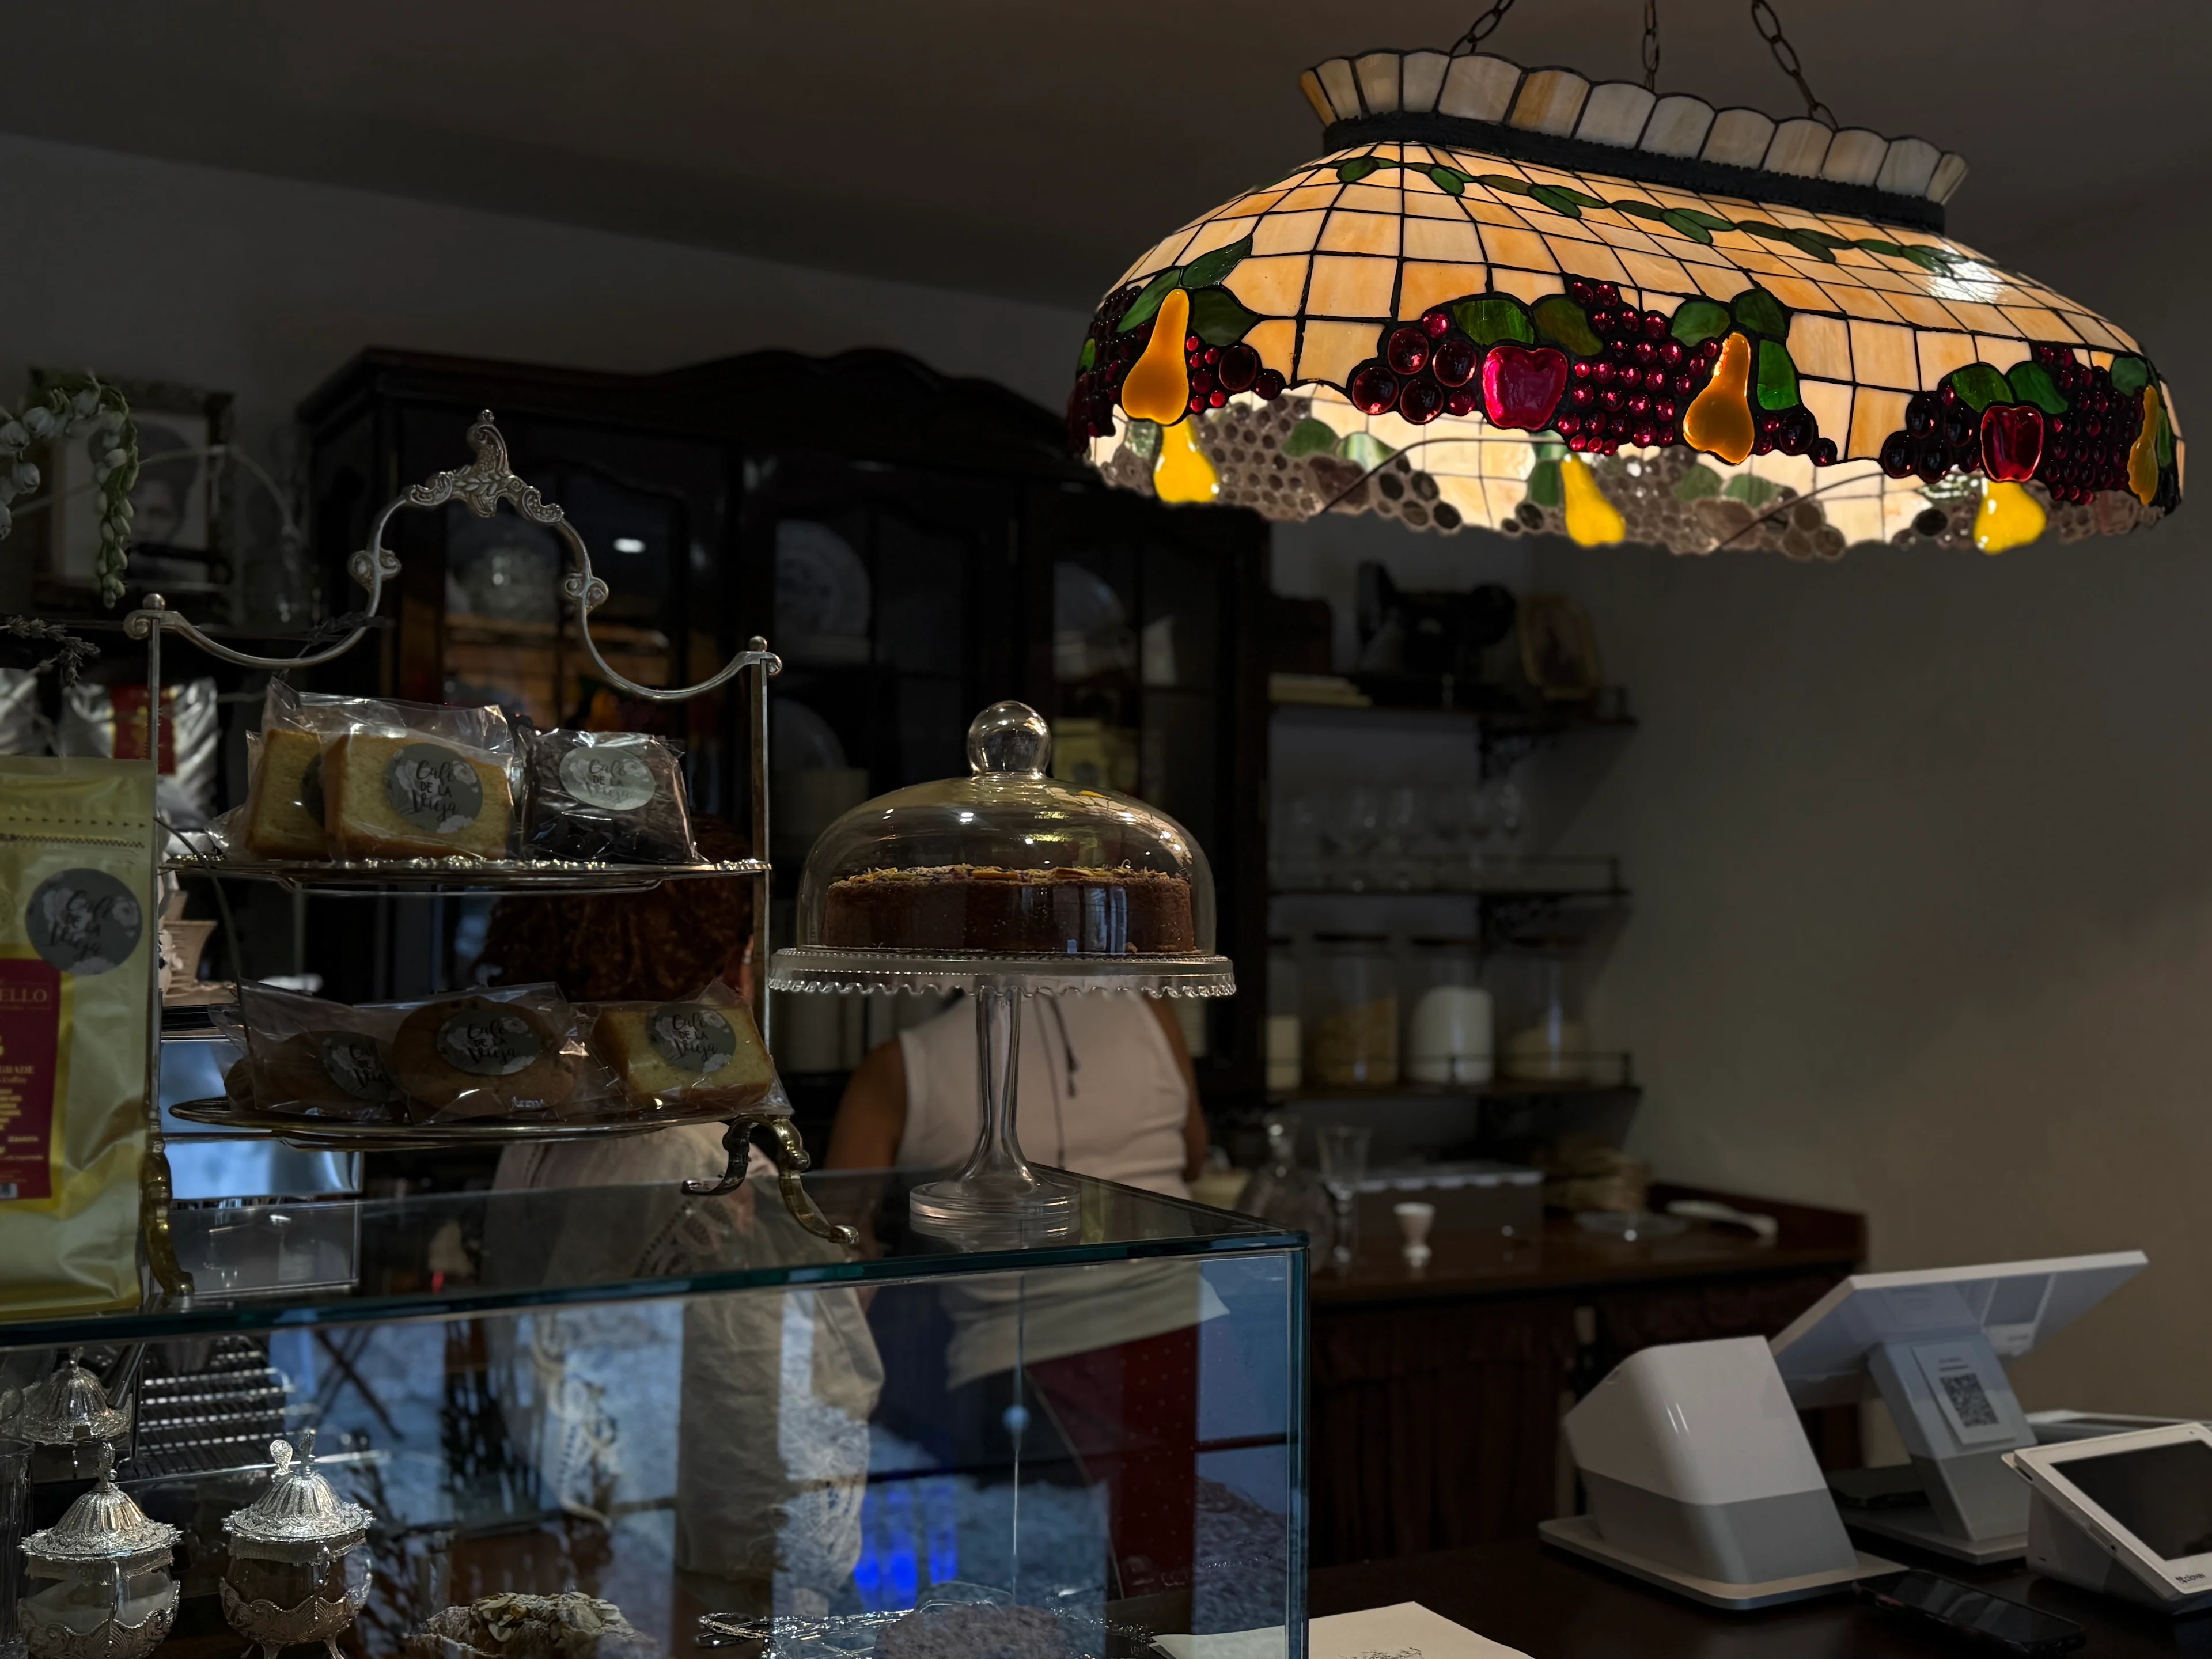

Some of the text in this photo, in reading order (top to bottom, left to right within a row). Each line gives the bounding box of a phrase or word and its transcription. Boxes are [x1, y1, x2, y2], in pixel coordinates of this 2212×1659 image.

[593, 775, 624, 787] DE LA
[420, 781, 452, 798] DE LA
[412, 789, 460, 822] Vieja
[474, 1037, 508, 1047] DE LA
[679, 1031, 709, 1040] DE LA
[467, 1047, 520, 1066] Vieja
[673, 1039, 718, 1062] Vieja
[2184, 1573, 2206, 1581] clover
